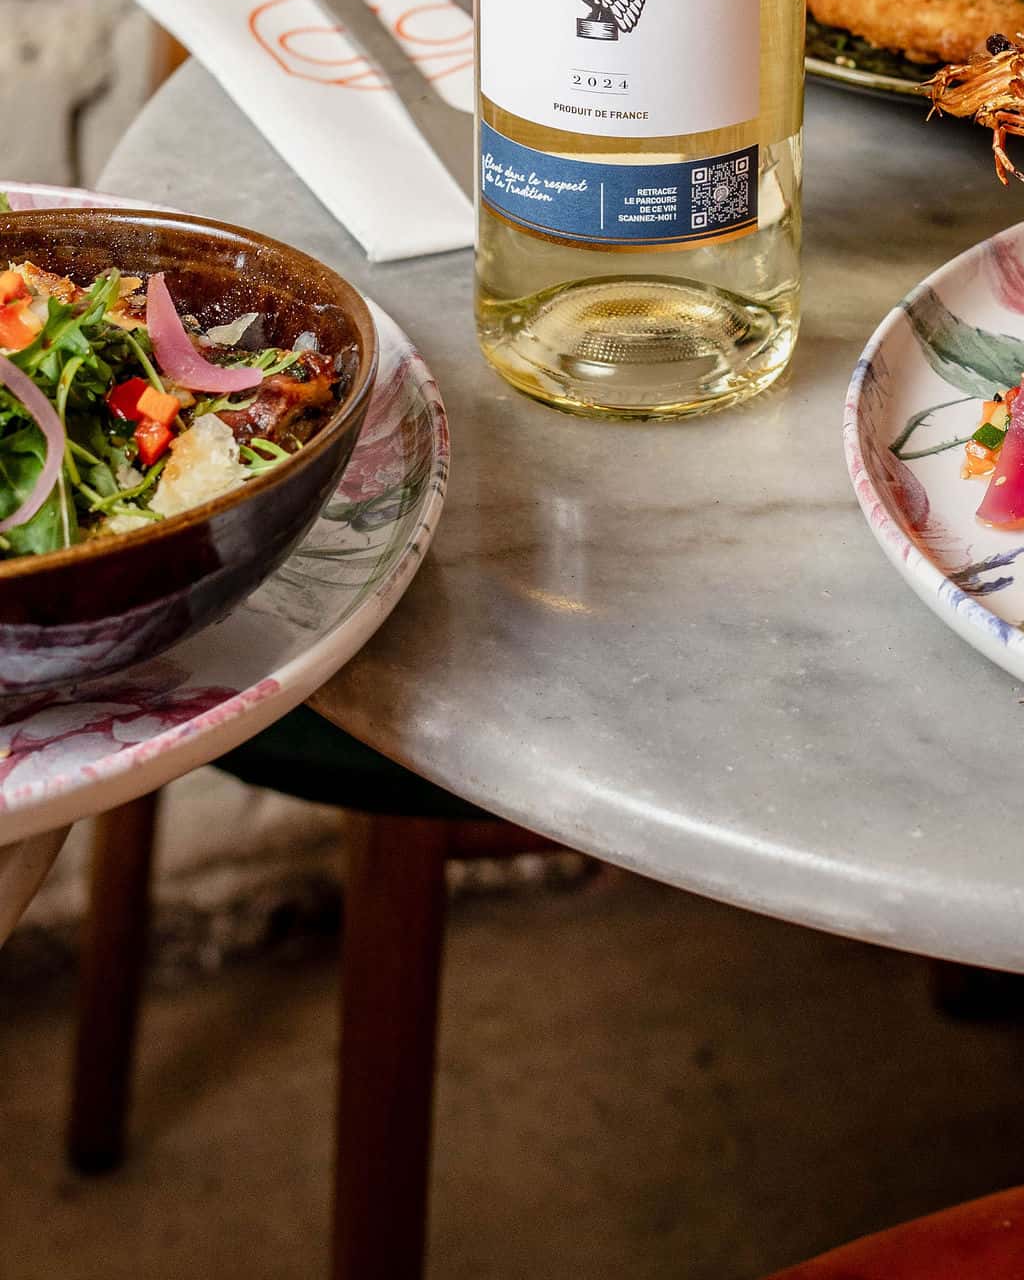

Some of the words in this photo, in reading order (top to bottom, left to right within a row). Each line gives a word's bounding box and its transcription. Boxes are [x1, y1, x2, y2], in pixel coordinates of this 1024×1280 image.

[553, 102, 592, 117] PRODUIT
[594, 109, 608, 119] DE
[610, 110, 649, 120] FRANCE
[485, 170, 494, 182] de
[494, 174, 506, 188] la
[505, 178, 553, 202] Tradition
[527, 171, 541, 186] le
[543, 179, 588, 194] respect
[637, 187, 677, 196] RETRACEZ
[624, 197, 635, 205] LE
[636, 195, 677, 205] PARCOURS
[639, 205, 651, 214] DE
[652, 205, 663, 213] CE
[663, 204, 677, 213] VIN
[618, 213, 672, 222] SCANNEZ-MOI
